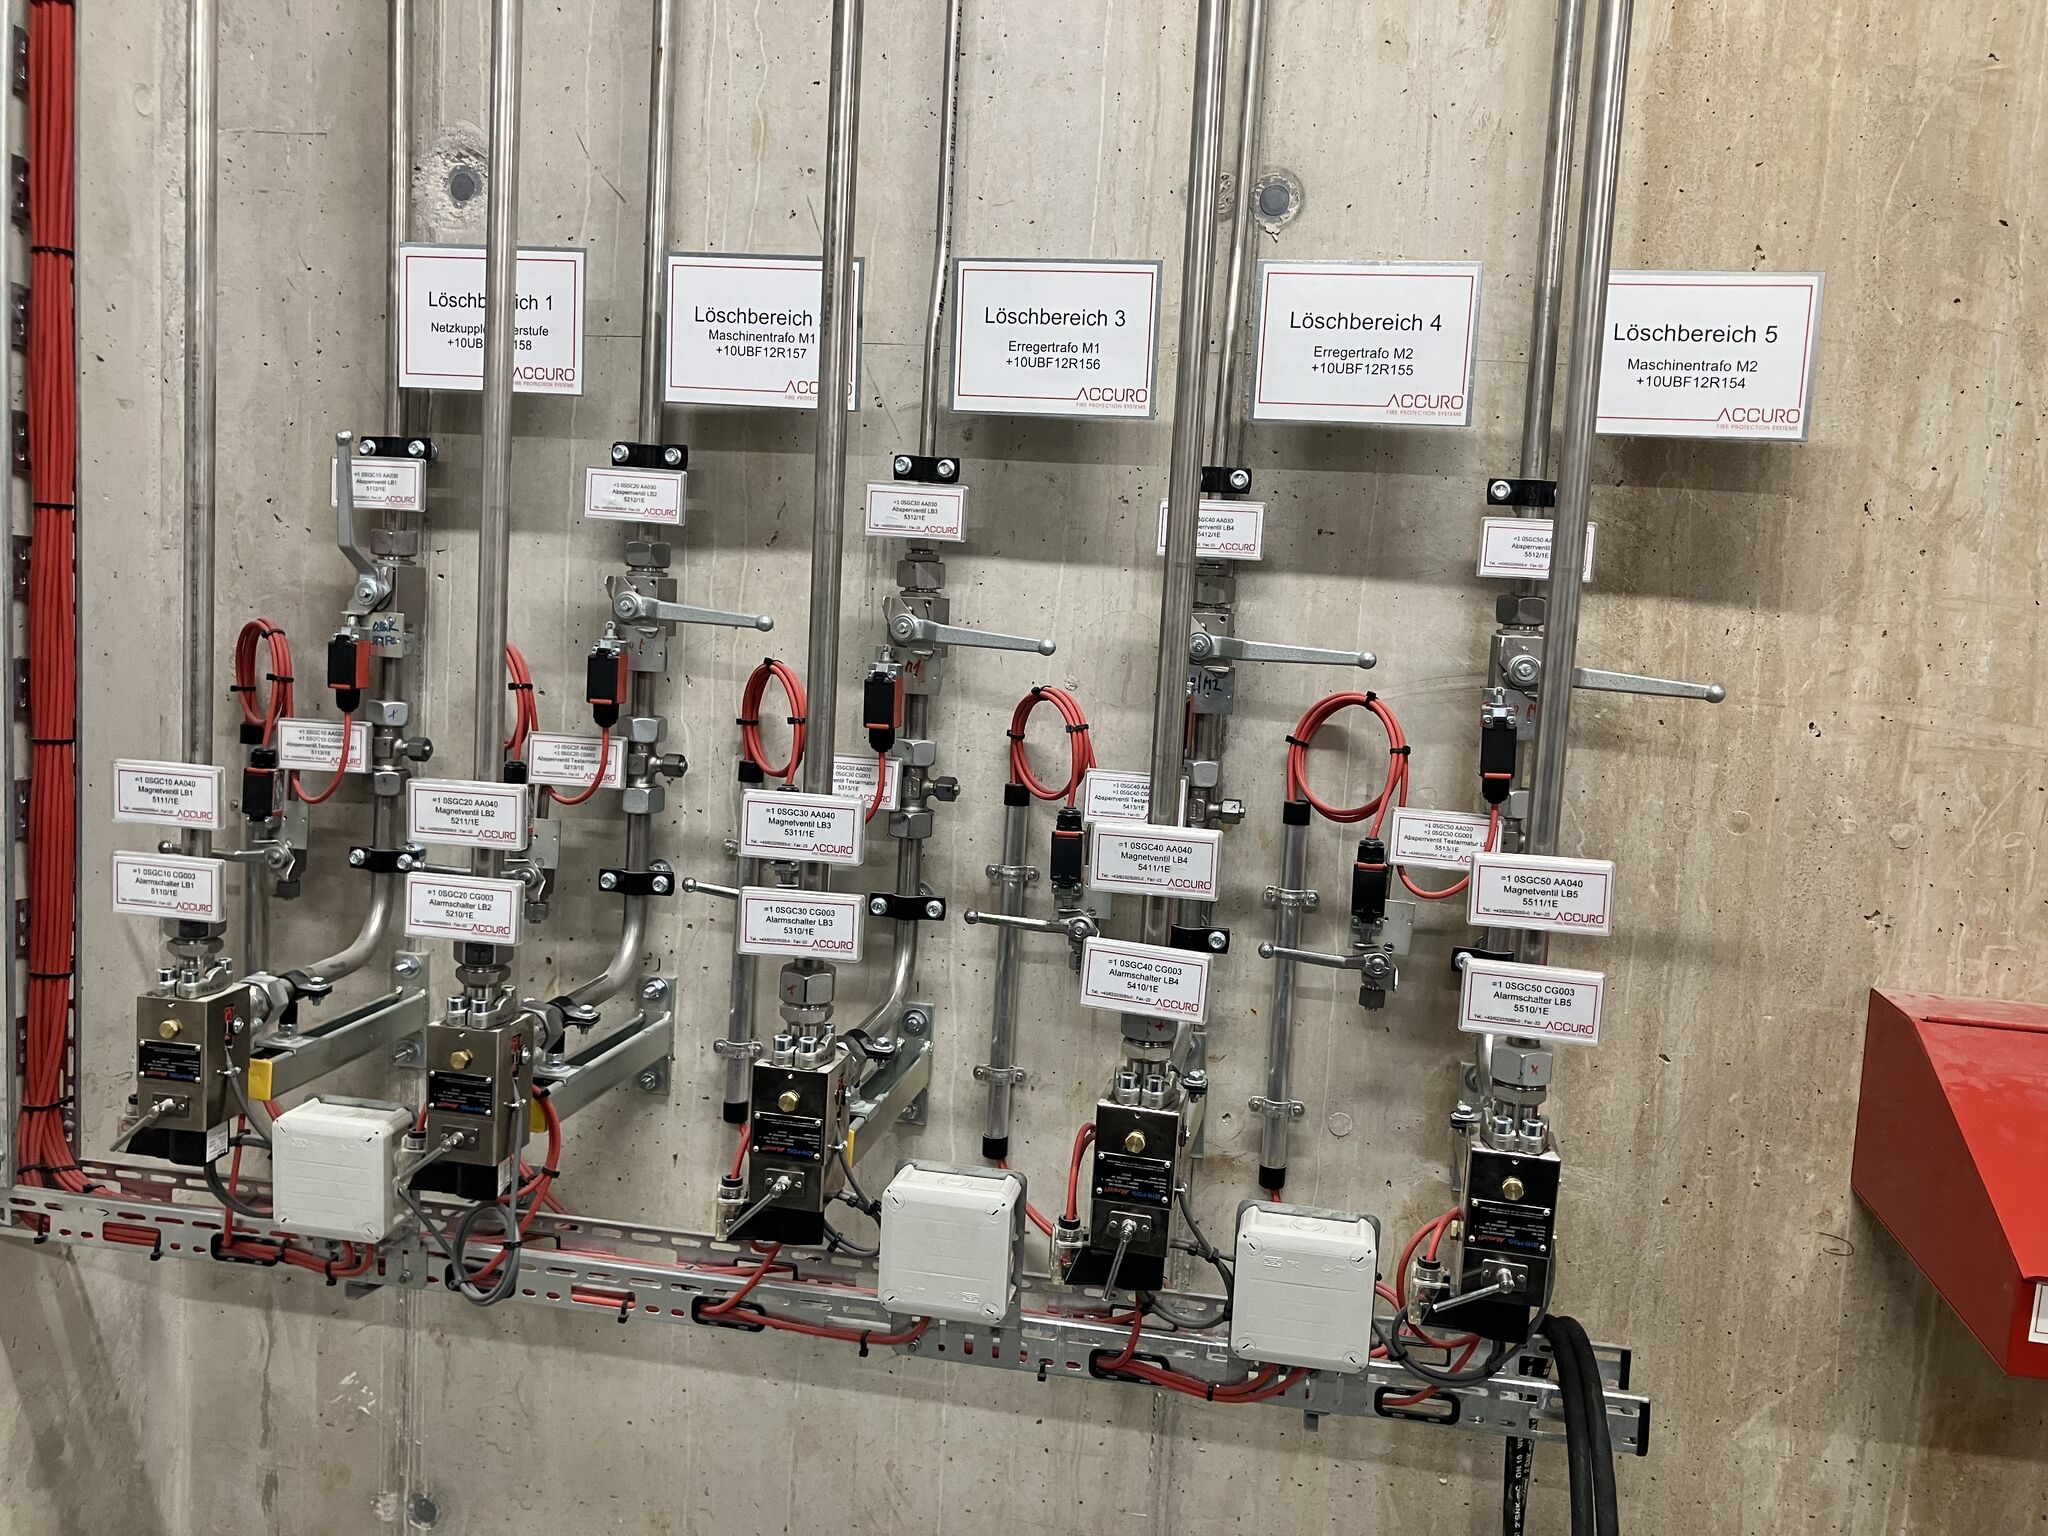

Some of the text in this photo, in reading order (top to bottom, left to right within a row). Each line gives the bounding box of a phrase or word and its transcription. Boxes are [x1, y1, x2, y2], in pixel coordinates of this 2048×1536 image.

[429, 291, 552, 310] Löschbich 1
[695, 306, 813, 326] Löschbereich
[985, 307, 1126, 326] Löschbereich 3
[1290, 311, 1442, 331] Löschbereich 4
[709, 330, 815, 344] Maschinentrafo M1
[1614, 323, 1778, 343] Löschbereich 5
[448, 338, 532, 350] +10UB158
[1008, 341, 1099, 354] Erregertrafo M1
[716, 346, 807, 359] +10UBF12R157
[1313, 346, 1413, 360] Erregertrafo M2
[1006, 357, 1100, 370] +10UBF12R156
[1628, 359, 1758, 372] Maschinentrafo M2
[513, 367, 575, 381] ACCURO
[1312, 363, 1413, 376] +10UBF12R155
[1637, 376, 1746, 388] +10UBF12R154
[1076, 387, 1147, 402] ACCURO
[1387, 394, 1463, 409] ACCURO
[1718, 408, 1800, 423] ACCURO
[924, 526, 958, 534] ACCURO
[1220, 543, 1255, 551] ACCURO
[138, 786, 178, 795] Magnetventil
[177, 810, 212, 819] ACCURO
[435, 807, 479, 816] Magnetventil
[777, 808, 808, 817] 0SGC30
[810, 811, 835, 819] AA040
[451, 818, 479, 826] 5211/1E
[769, 817, 831, 829] Magnetventil LB3
[478, 830, 516, 839] ACCURO
[785, 829, 814, 837] 5311/1E
[812, 844, 853, 854] ACCURO
[1130, 842, 1163, 852] 0SGC40
[1121, 852, 1170, 862] Magnetventil
[1138, 864, 1170, 873] 5411/1E
[1168, 879, 1211, 890] ACCURO
[1514, 876, 1551, 885] 0SGC50
[1504, 886, 1558, 897] Magnetventil
[429, 899, 476, 909] Alarmschalter
[1523, 898, 1558, 908] 5511/1E
[446, 910, 473, 919] 5210/1E
[776, 907, 807, 915] 0SGC30
[766, 916, 816, 925] Alarmschalter
[1555, 912, 1604, 924] ACCURO
[472, 924, 510, 934] ACCURO
[784, 927, 814, 935] 5310/1E
[812, 940, 853, 949] ACCURO
[1120, 960, 1153, 971] 0SGC40
[1155, 965, 1182, 975] CG003
[1109, 969, 1179, 985] Alarmschalter LB4
[1127, 982, 1158, 993] 5410/1E
[1505, 982, 1542, 992] 0SGC50
[1545, 986, 1575, 996] CG003
[1494, 991, 1571, 1007] Alarmschalter LB5
[1155, 999, 1198, 1012] ACCURO
[1514, 1004, 1549, 1015] 5510/1E
[1546, 1021, 1593, 1034] ACCURO
